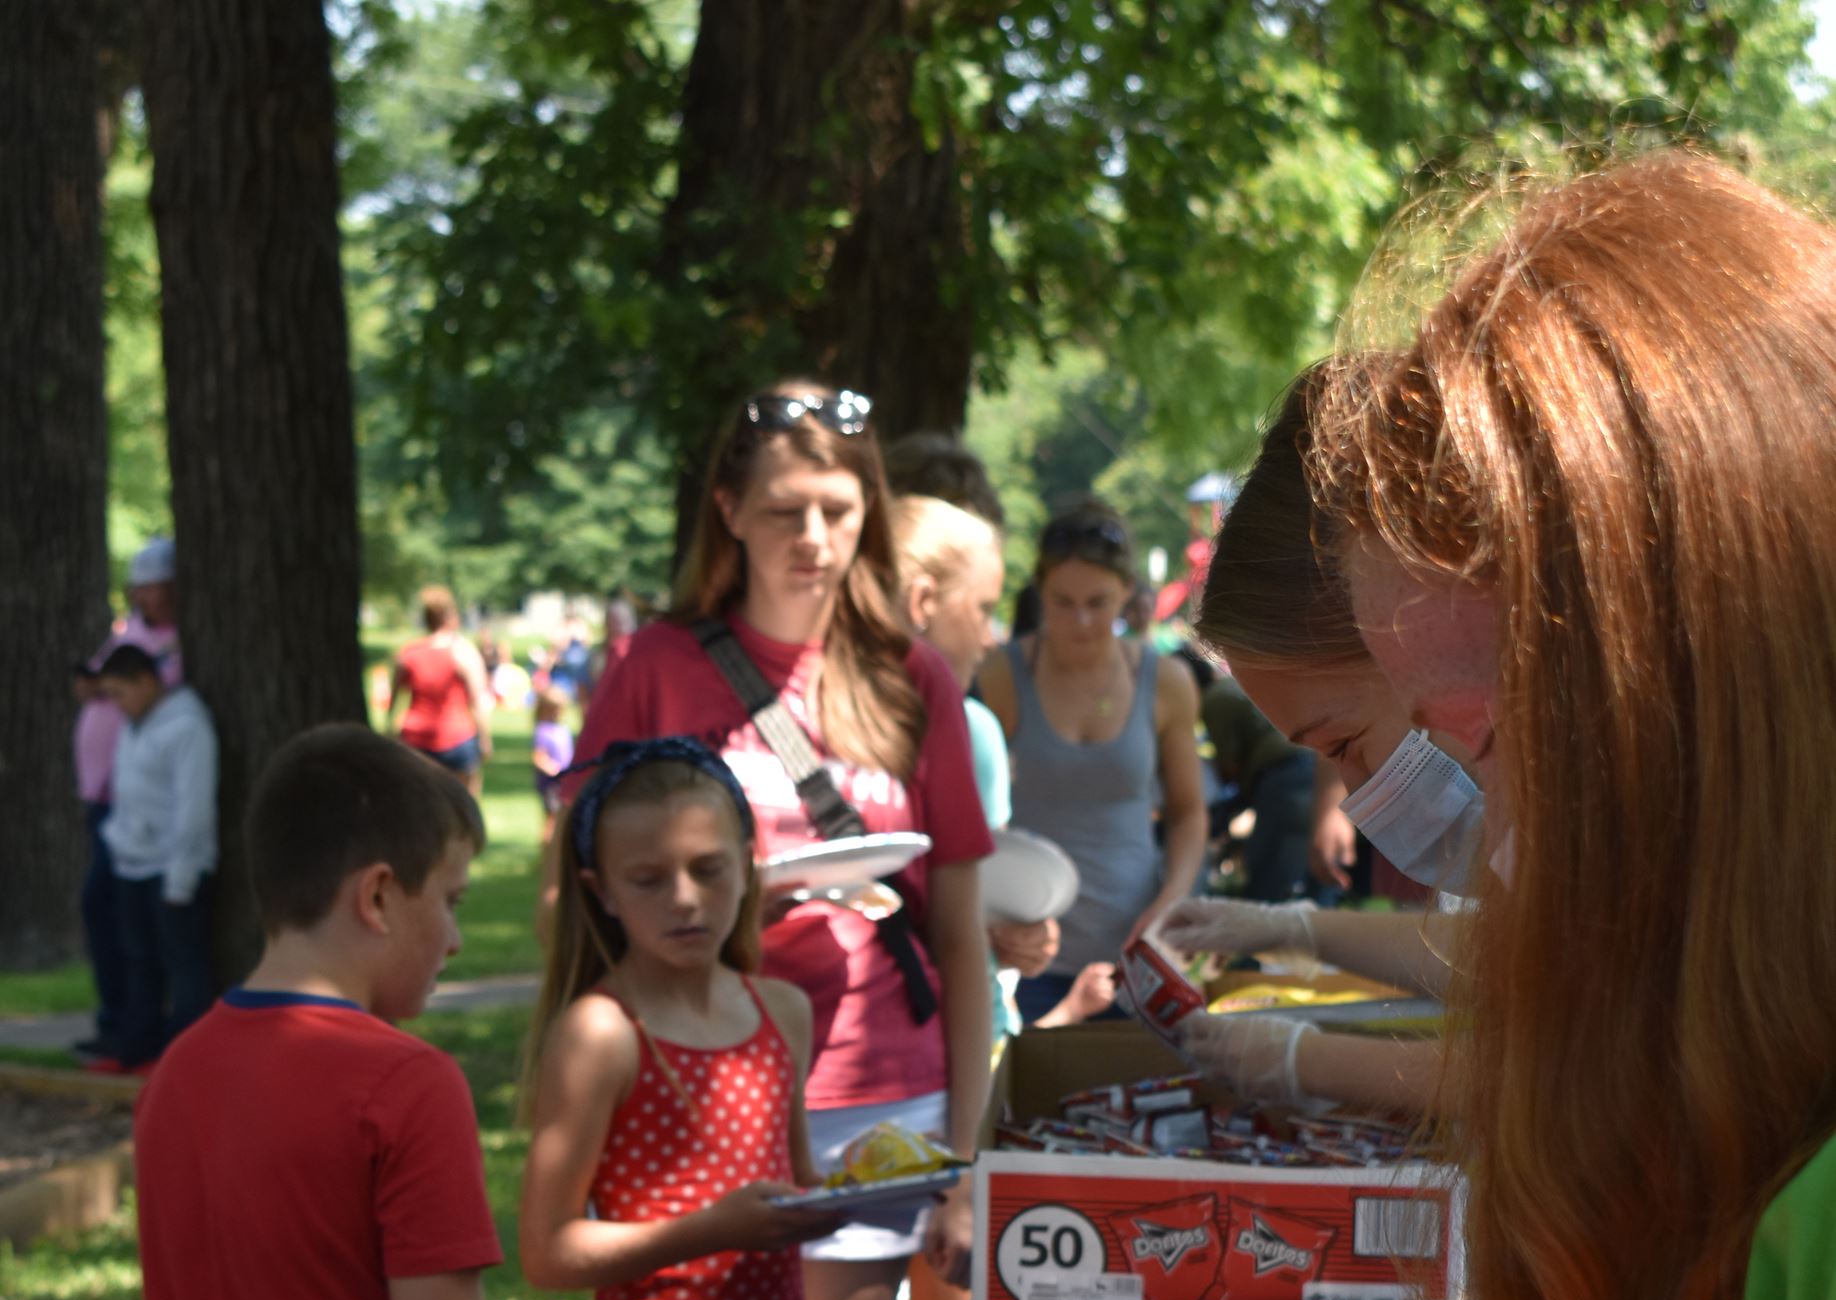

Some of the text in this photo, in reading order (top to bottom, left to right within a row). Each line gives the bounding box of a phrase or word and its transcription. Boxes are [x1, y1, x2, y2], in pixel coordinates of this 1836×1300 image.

[1019, 1224, 1083, 1268] 50
[1132, 1225, 1209, 1260] Doritos
[1236, 1228, 1313, 1270] Doritos
